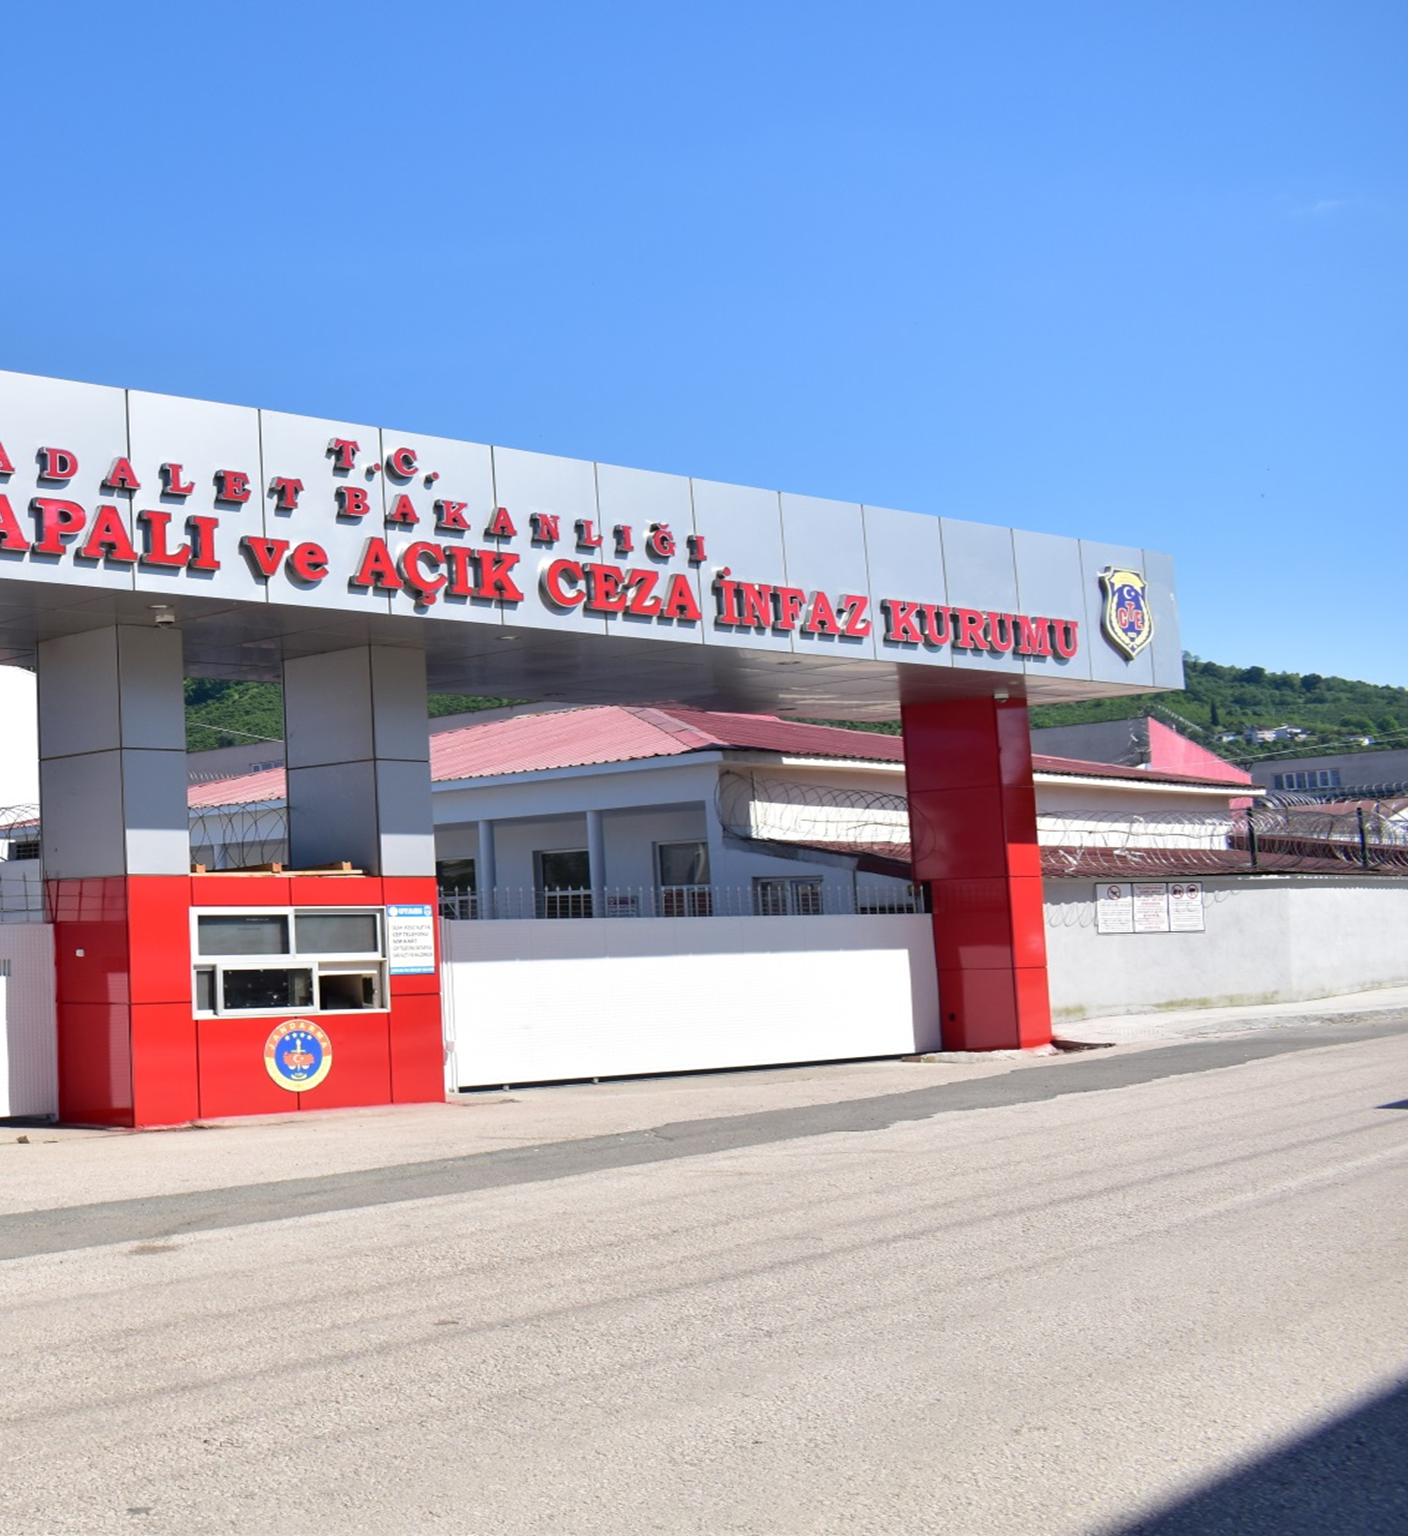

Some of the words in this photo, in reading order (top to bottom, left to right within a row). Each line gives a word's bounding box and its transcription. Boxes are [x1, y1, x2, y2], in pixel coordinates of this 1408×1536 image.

[330, 438, 440, 482] T.C.
[338, 486, 708, 563] BAKANLIĞI
[244, 535, 329, 582] ve
[352, 536, 525, 606] AÇIK
[544, 556, 703, 622] CEZA
[715, 566, 873, 639] İNFAZ
[886, 598, 1079, 660] KURUMU
[269, 1022, 328, 1049] JANDARMA
